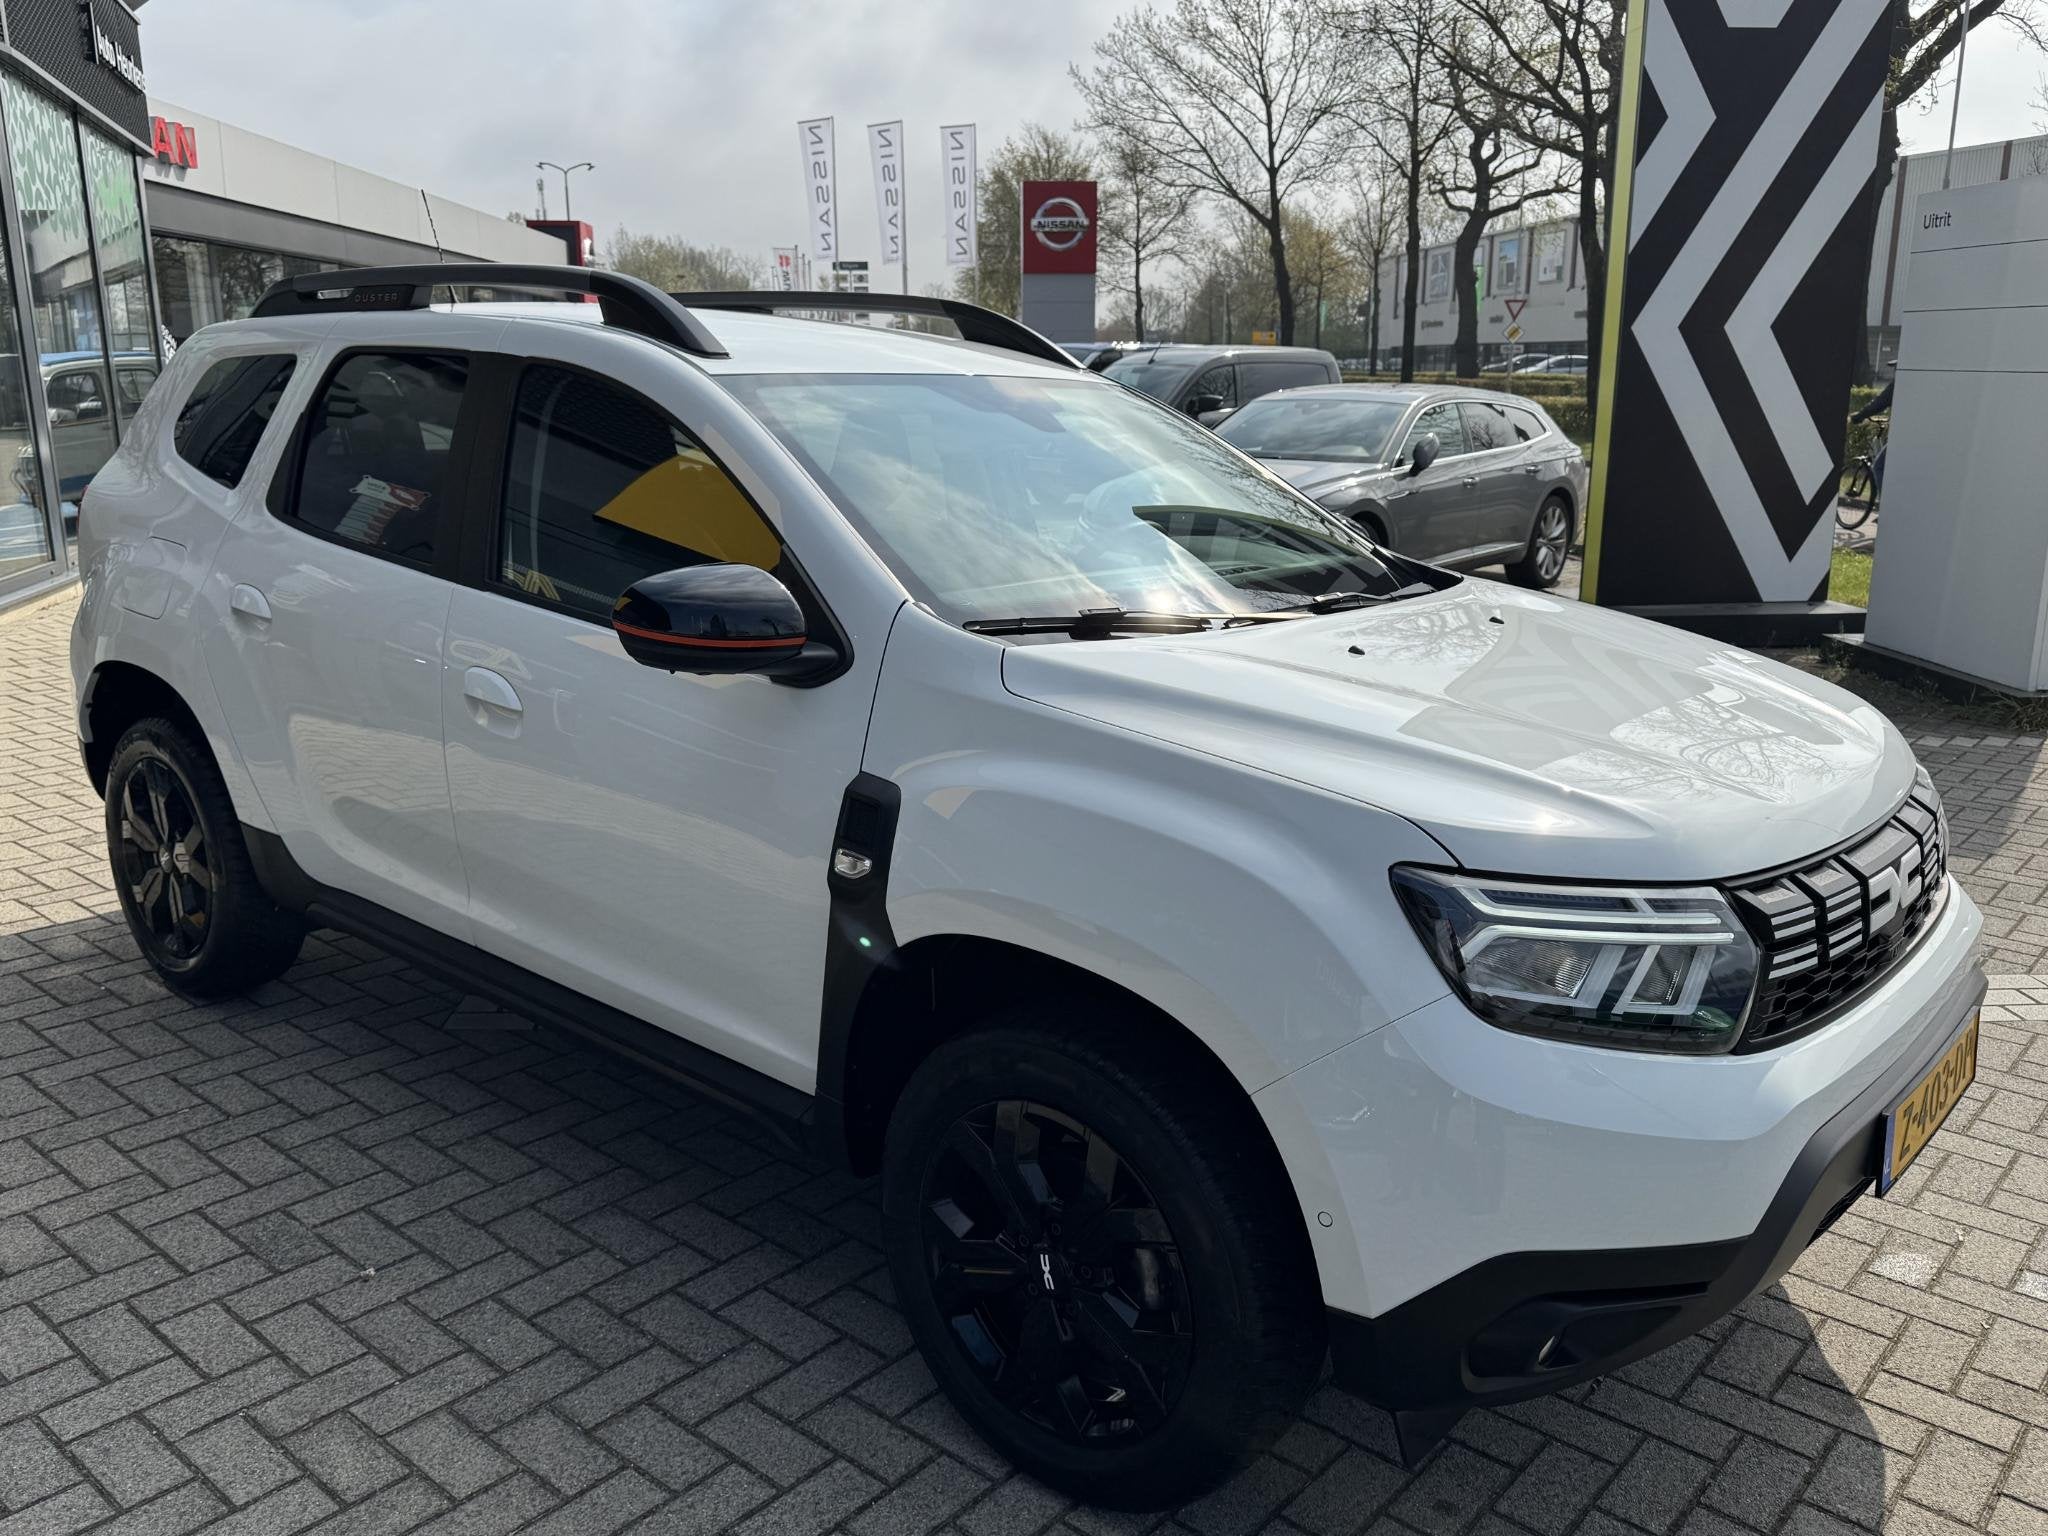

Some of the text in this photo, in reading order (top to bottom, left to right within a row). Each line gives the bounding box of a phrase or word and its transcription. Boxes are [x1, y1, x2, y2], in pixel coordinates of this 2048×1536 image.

[153, 116, 198, 169] AN
[1035, 220, 1084, 229] NISSAN
[1923, 211, 1951, 229] Uitrit
